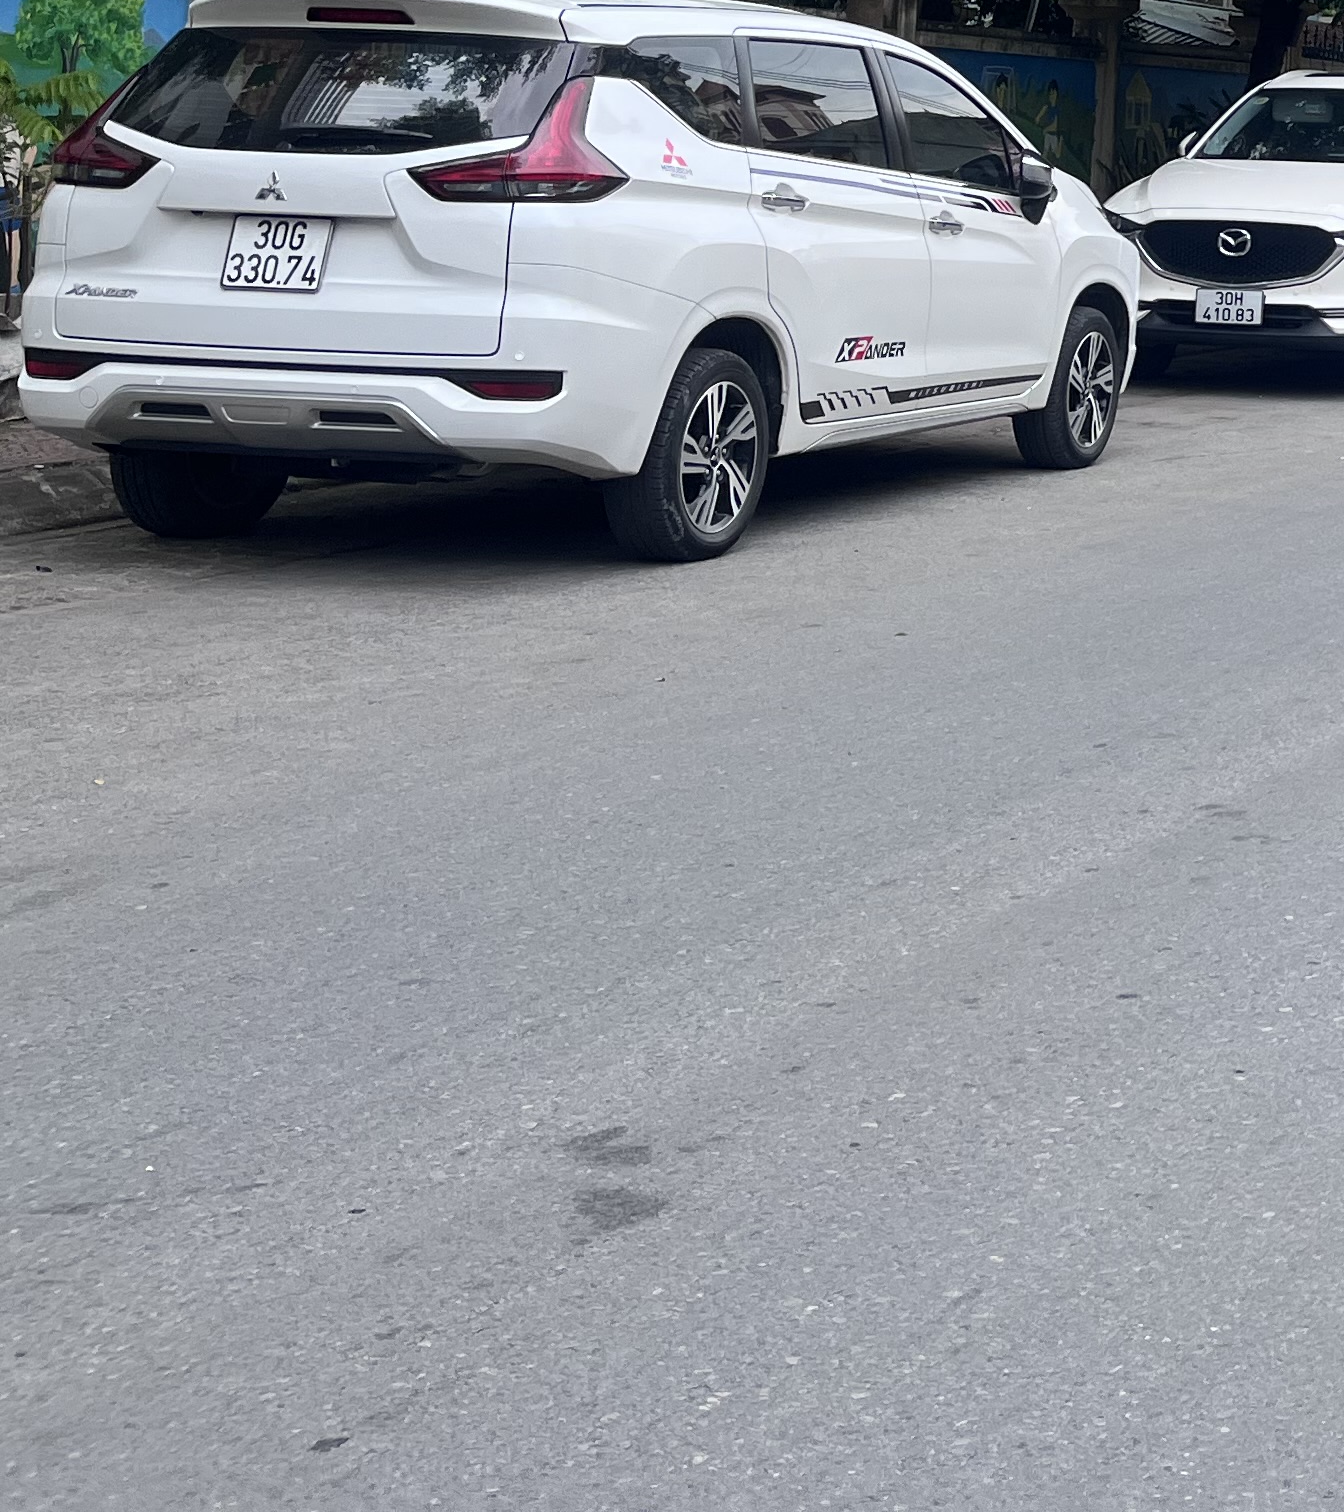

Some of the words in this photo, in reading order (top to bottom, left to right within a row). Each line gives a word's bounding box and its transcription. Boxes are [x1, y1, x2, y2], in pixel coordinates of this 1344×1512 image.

[253, 220, 308, 251] 30G
[226, 253, 317, 286] 330.74
[1214, 291, 1244, 306] 30H
[1202, 306, 1255, 323] 410.83
